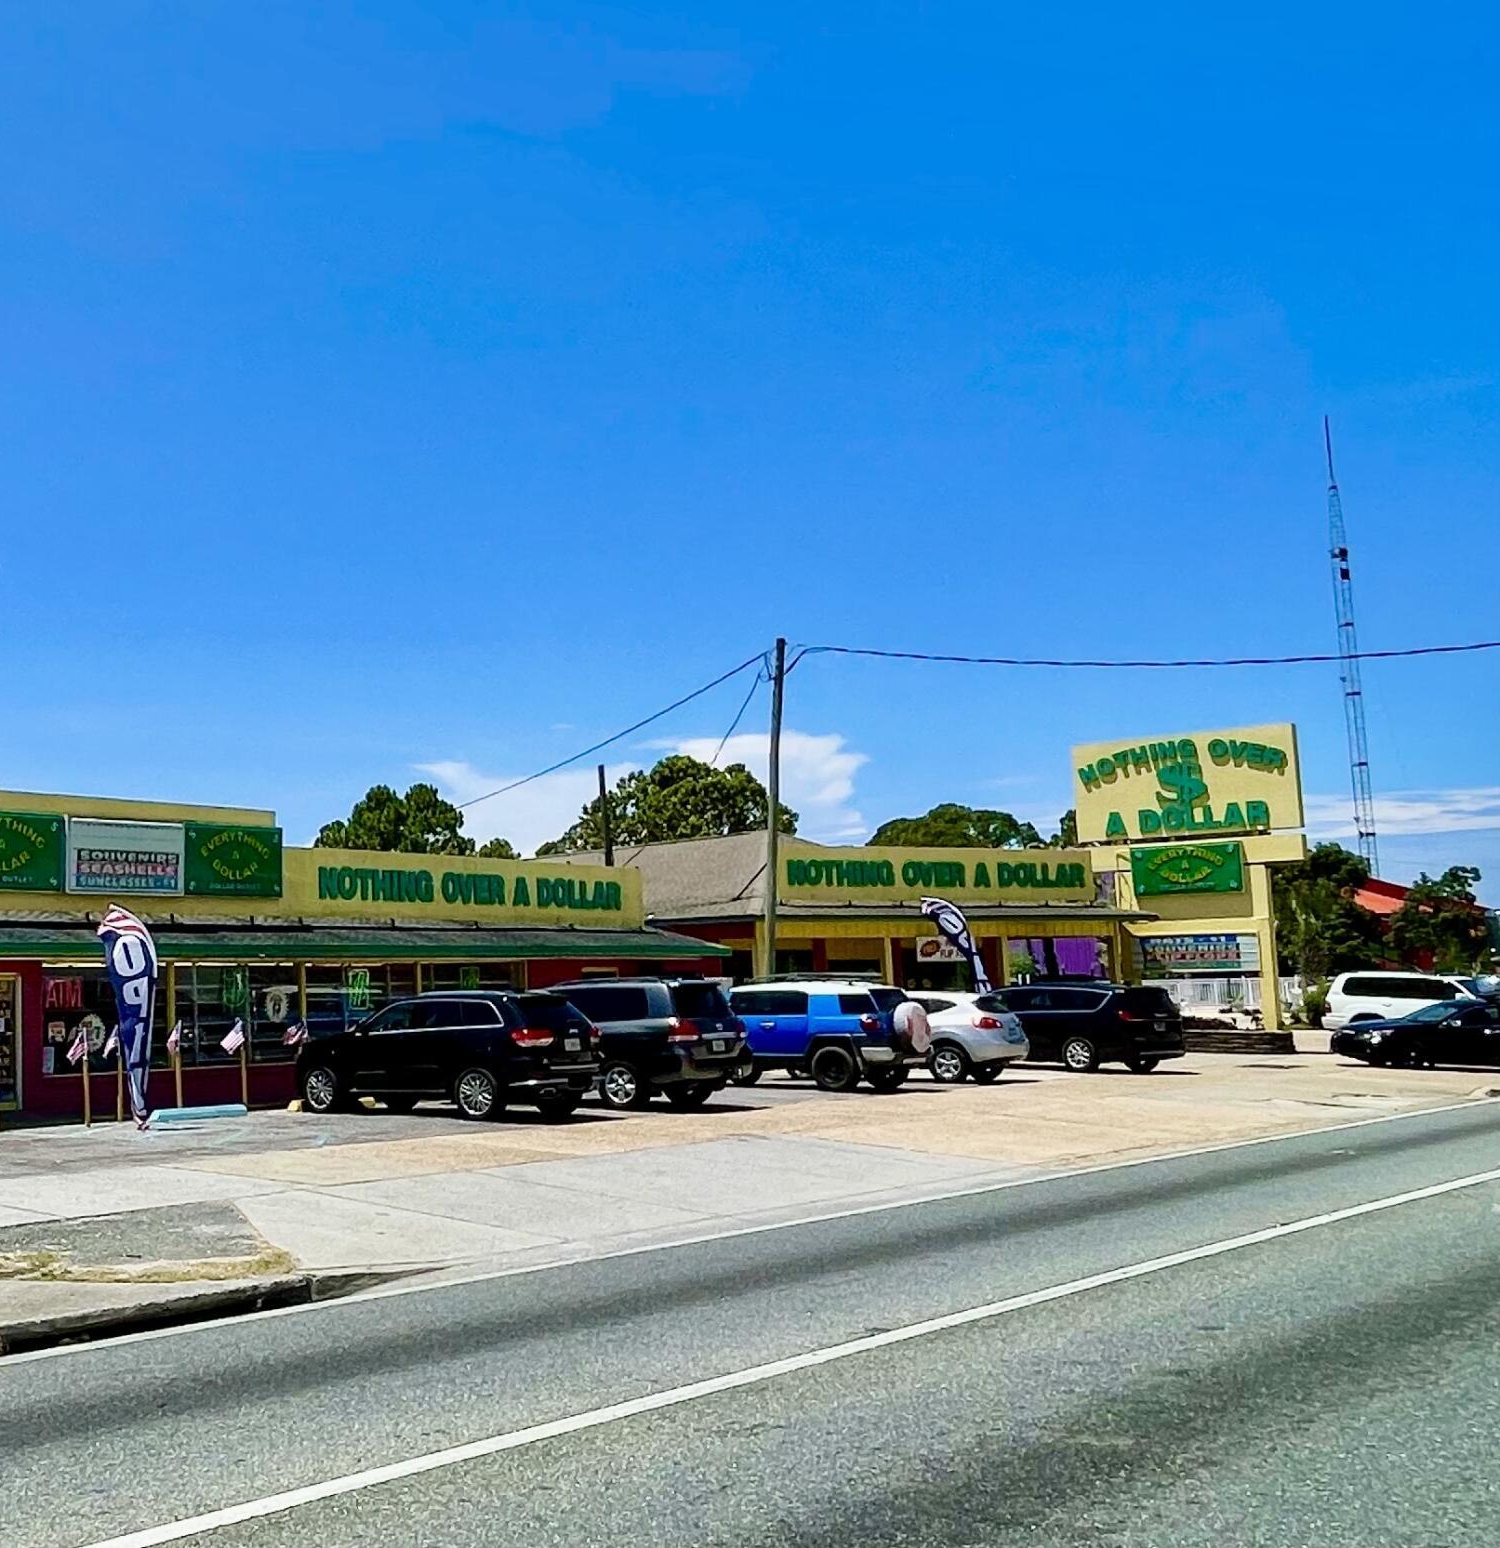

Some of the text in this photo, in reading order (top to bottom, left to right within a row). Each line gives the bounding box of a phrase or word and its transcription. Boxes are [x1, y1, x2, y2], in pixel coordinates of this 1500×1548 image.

[1078, 739, 1288, 793] NOTHING OVER
[1106, 800, 1270, 838] A DOLLAR
[80, 850, 177, 864] SOUVENIRS
[200, 831, 270, 859] EVERYTHING
[79, 862, 176, 876] SEASHELLS
[212, 859, 259, 880] DOLLAR
[787, 859, 1086, 888] NOTHING OVER A DOLLAR
[318, 866, 622, 911] NOTHING OVER A DOLLAR
[45, 979, 83, 1008] ATM
